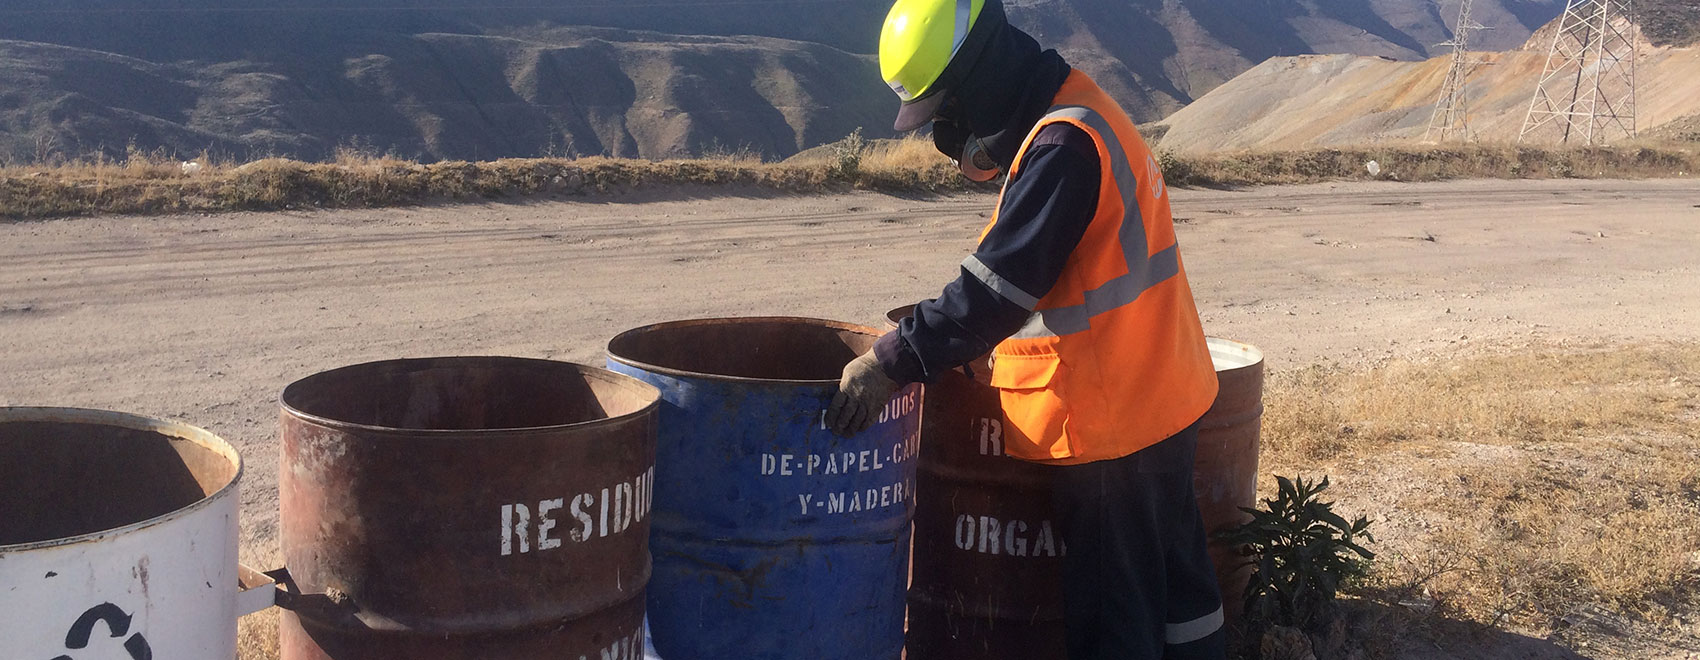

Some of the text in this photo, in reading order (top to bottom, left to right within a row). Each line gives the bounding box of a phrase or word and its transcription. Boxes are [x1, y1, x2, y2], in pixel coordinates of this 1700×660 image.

[761, 431, 920, 476] DE-PAPEL-CAR
[501, 465, 655, 556] RESIDUO
[955, 514, 1068, 558] ORGA
